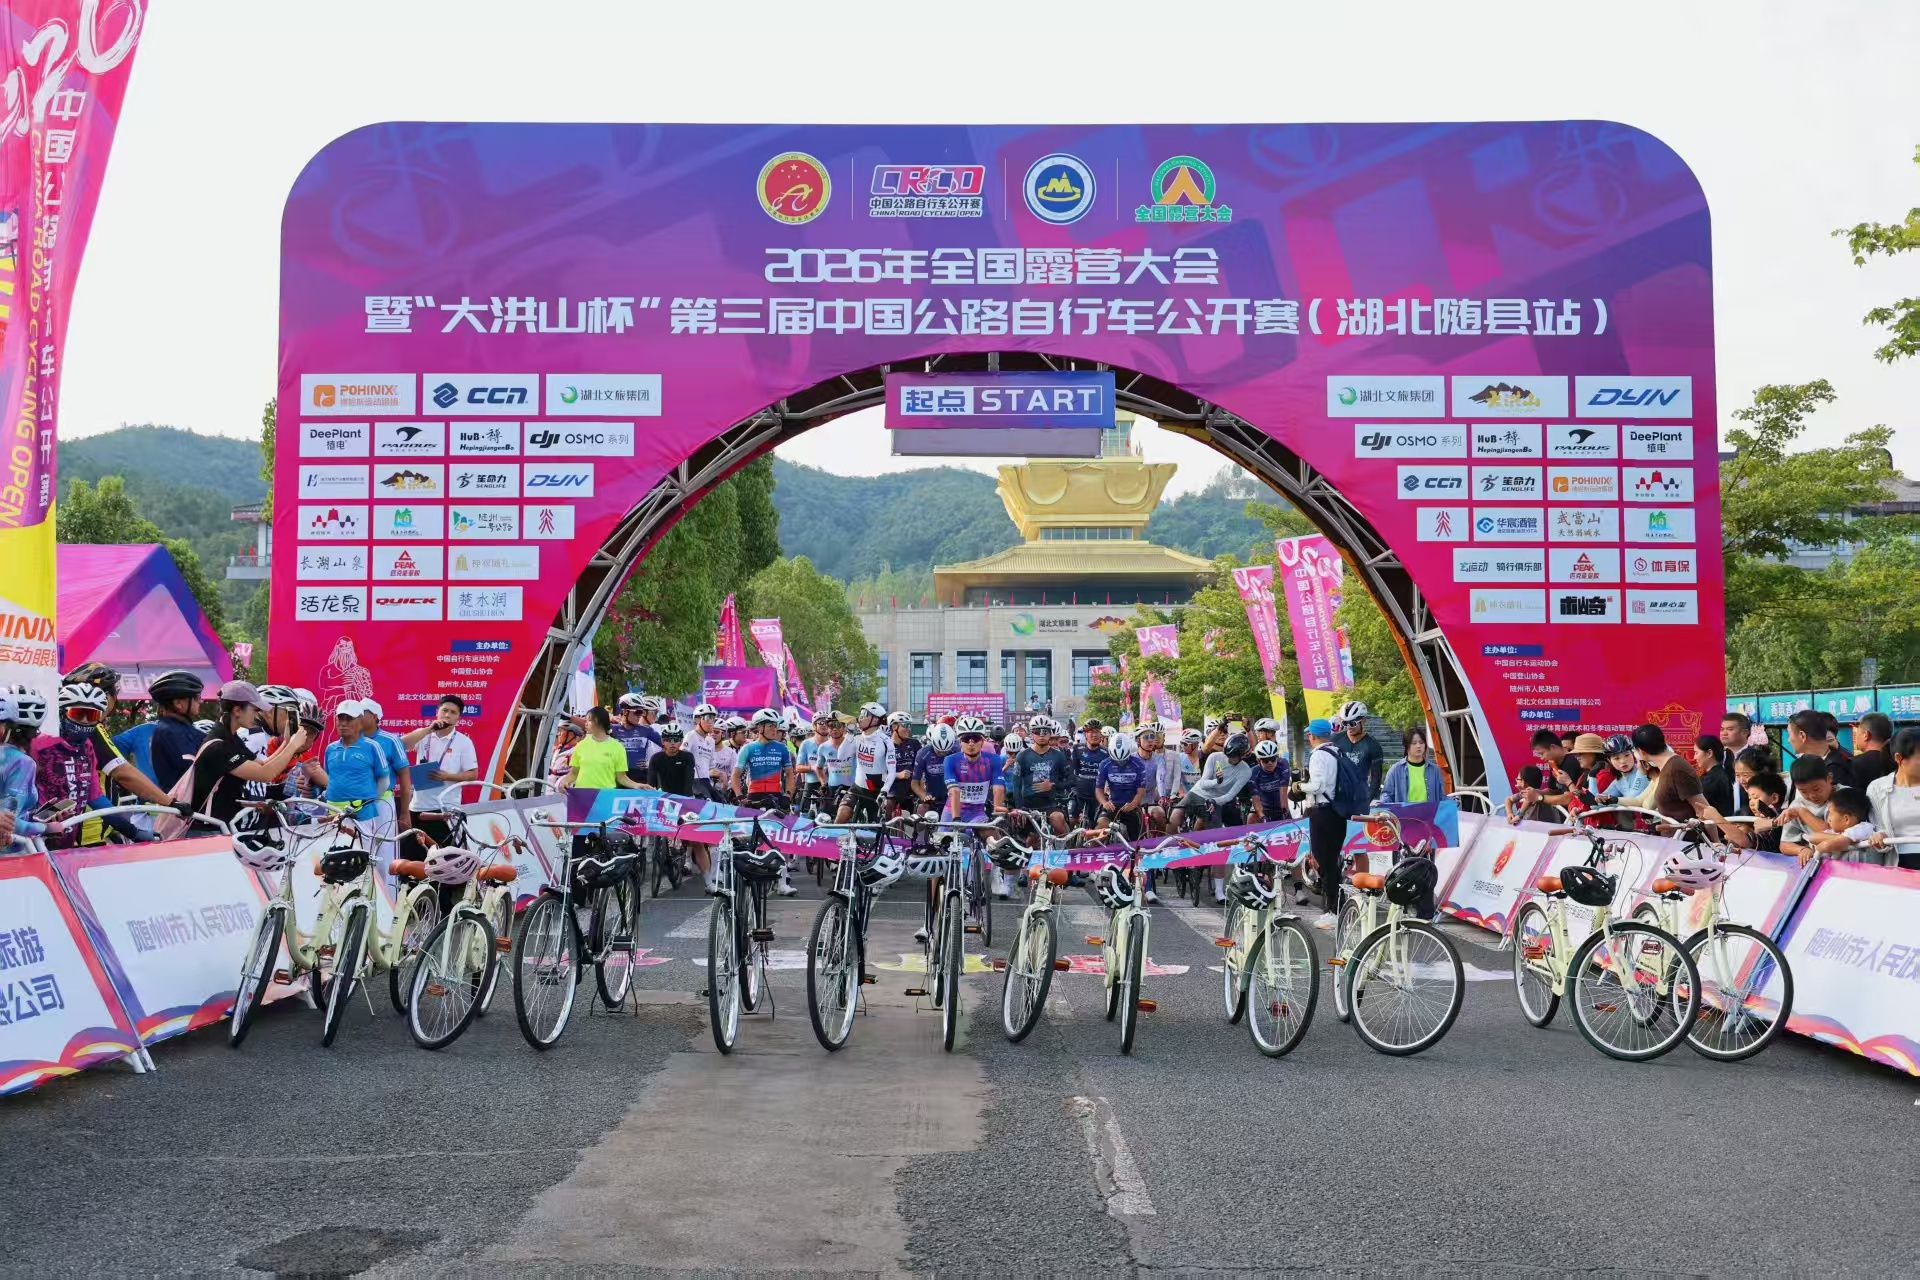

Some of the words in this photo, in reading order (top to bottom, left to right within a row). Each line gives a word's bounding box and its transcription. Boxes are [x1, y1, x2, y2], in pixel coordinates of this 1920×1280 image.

[871, 198, 982, 209] 中国公路自行车公开赛
[871, 209, 895, 217] CHINA
[898, 209, 922, 217] ROAD
[960, 209, 981, 217] OPEN
[1135, 205, 1232, 222] 全国露营大会
[764, 248, 1220, 285] 2026年全国露营大会
[580, 389, 650, 401] 湖北文旅集团
[1359, 390, 1434, 402] 湖北文旅集团
[905, 389, 966, 413] 起点
[981, 388, 1097, 412] START
[310, 429, 362, 438] DeePlant
[1630, 431, 1682, 441] DeePlant
[565, 433, 605, 444] OSMO
[608, 434, 629, 445] 系列
[1396, 435, 1437, 446] OSMO
[1441, 436, 1462, 447] 系列
[1497, 517, 1538, 528] 华宸酒管
[394, 561, 416, 569] PEAK
[1496, 562, 1542, 572] 骑行俱乐部
[1573, 564, 1595, 572] PEAK
[1651, 560, 1690, 572] 体育保
[375, 598, 437, 606] QUICK
[437, 655, 500, 663] 中国自行车运动协会
[1494, 659, 1558, 667] 中国自行车运动协会
[1503, 672, 1546, 680] 中国登山协会
[437, 680, 488, 688] 随州市人民政府
[1509, 685, 1560, 693] 随州市人民政府
[1516, 698, 1602, 706] 湖北文化旅游集团有限公司
[859, 744, 876, 756] UAE
[126, 902, 256, 953] 随州市人民政府
